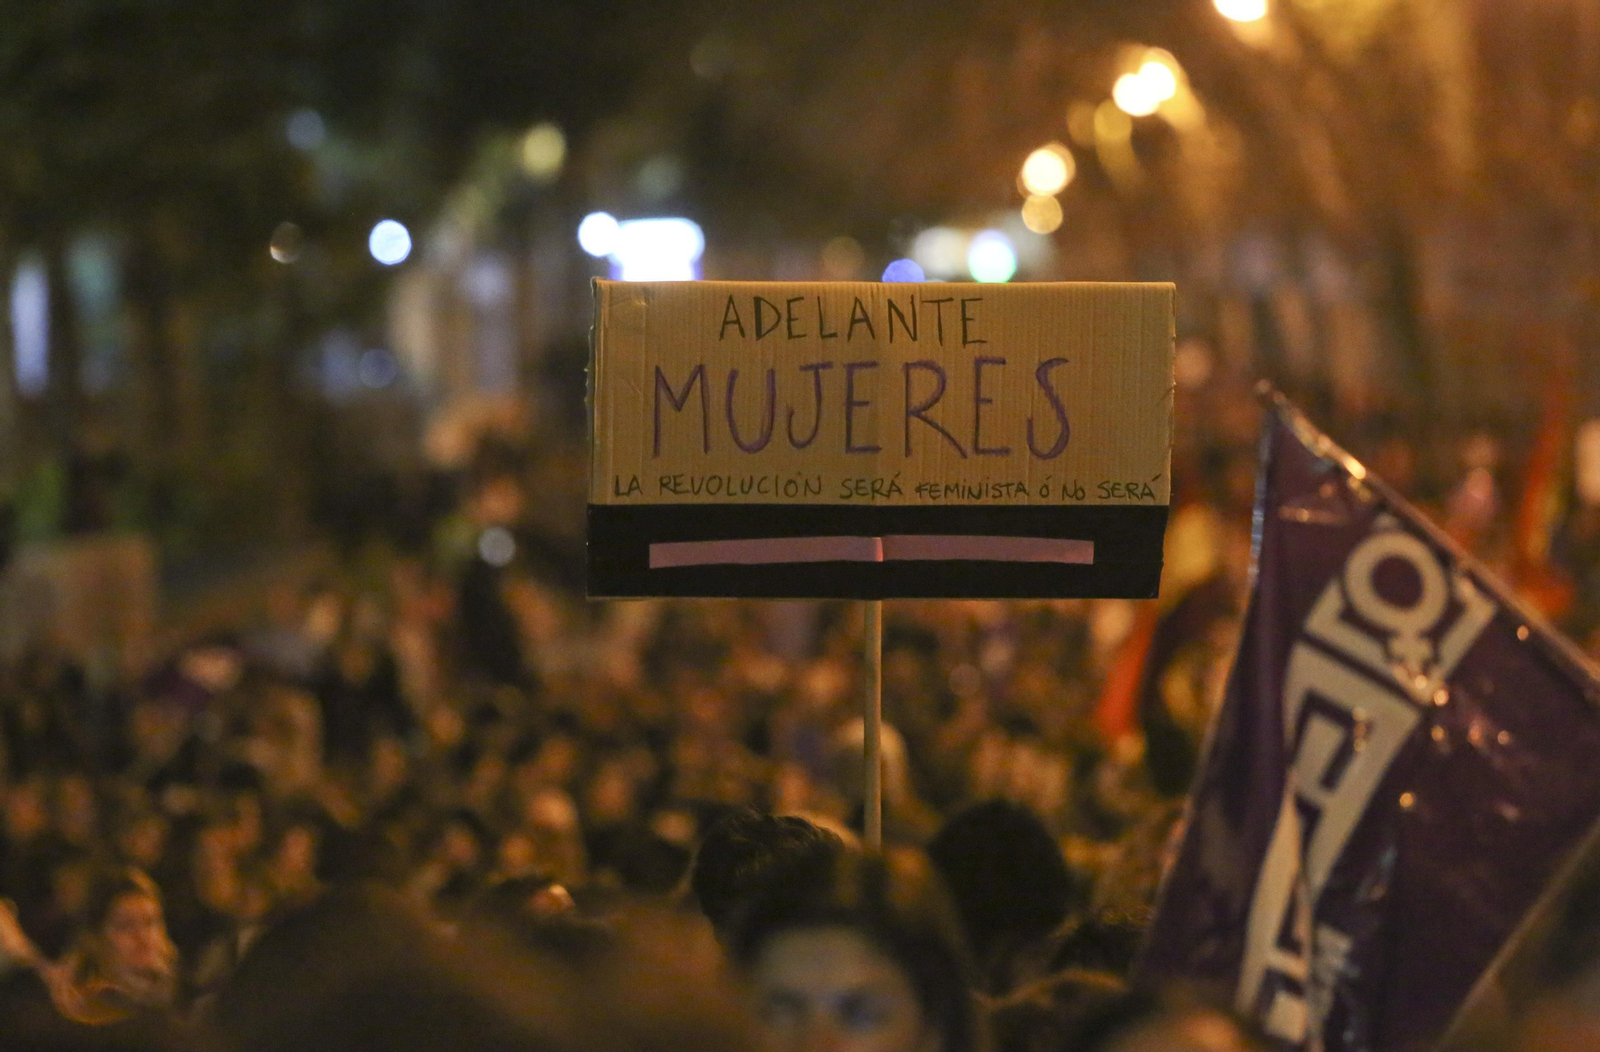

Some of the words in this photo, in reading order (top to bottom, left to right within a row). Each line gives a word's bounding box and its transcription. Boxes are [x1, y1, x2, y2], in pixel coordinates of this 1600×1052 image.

[719, 294, 988, 346] ADELANTE
[652, 356, 1071, 460] MUJERES
[614, 474, 643, 497] LA
[839, 471, 903, 500] SERÁ
[1097, 473, 1162, 501] SERÁ
